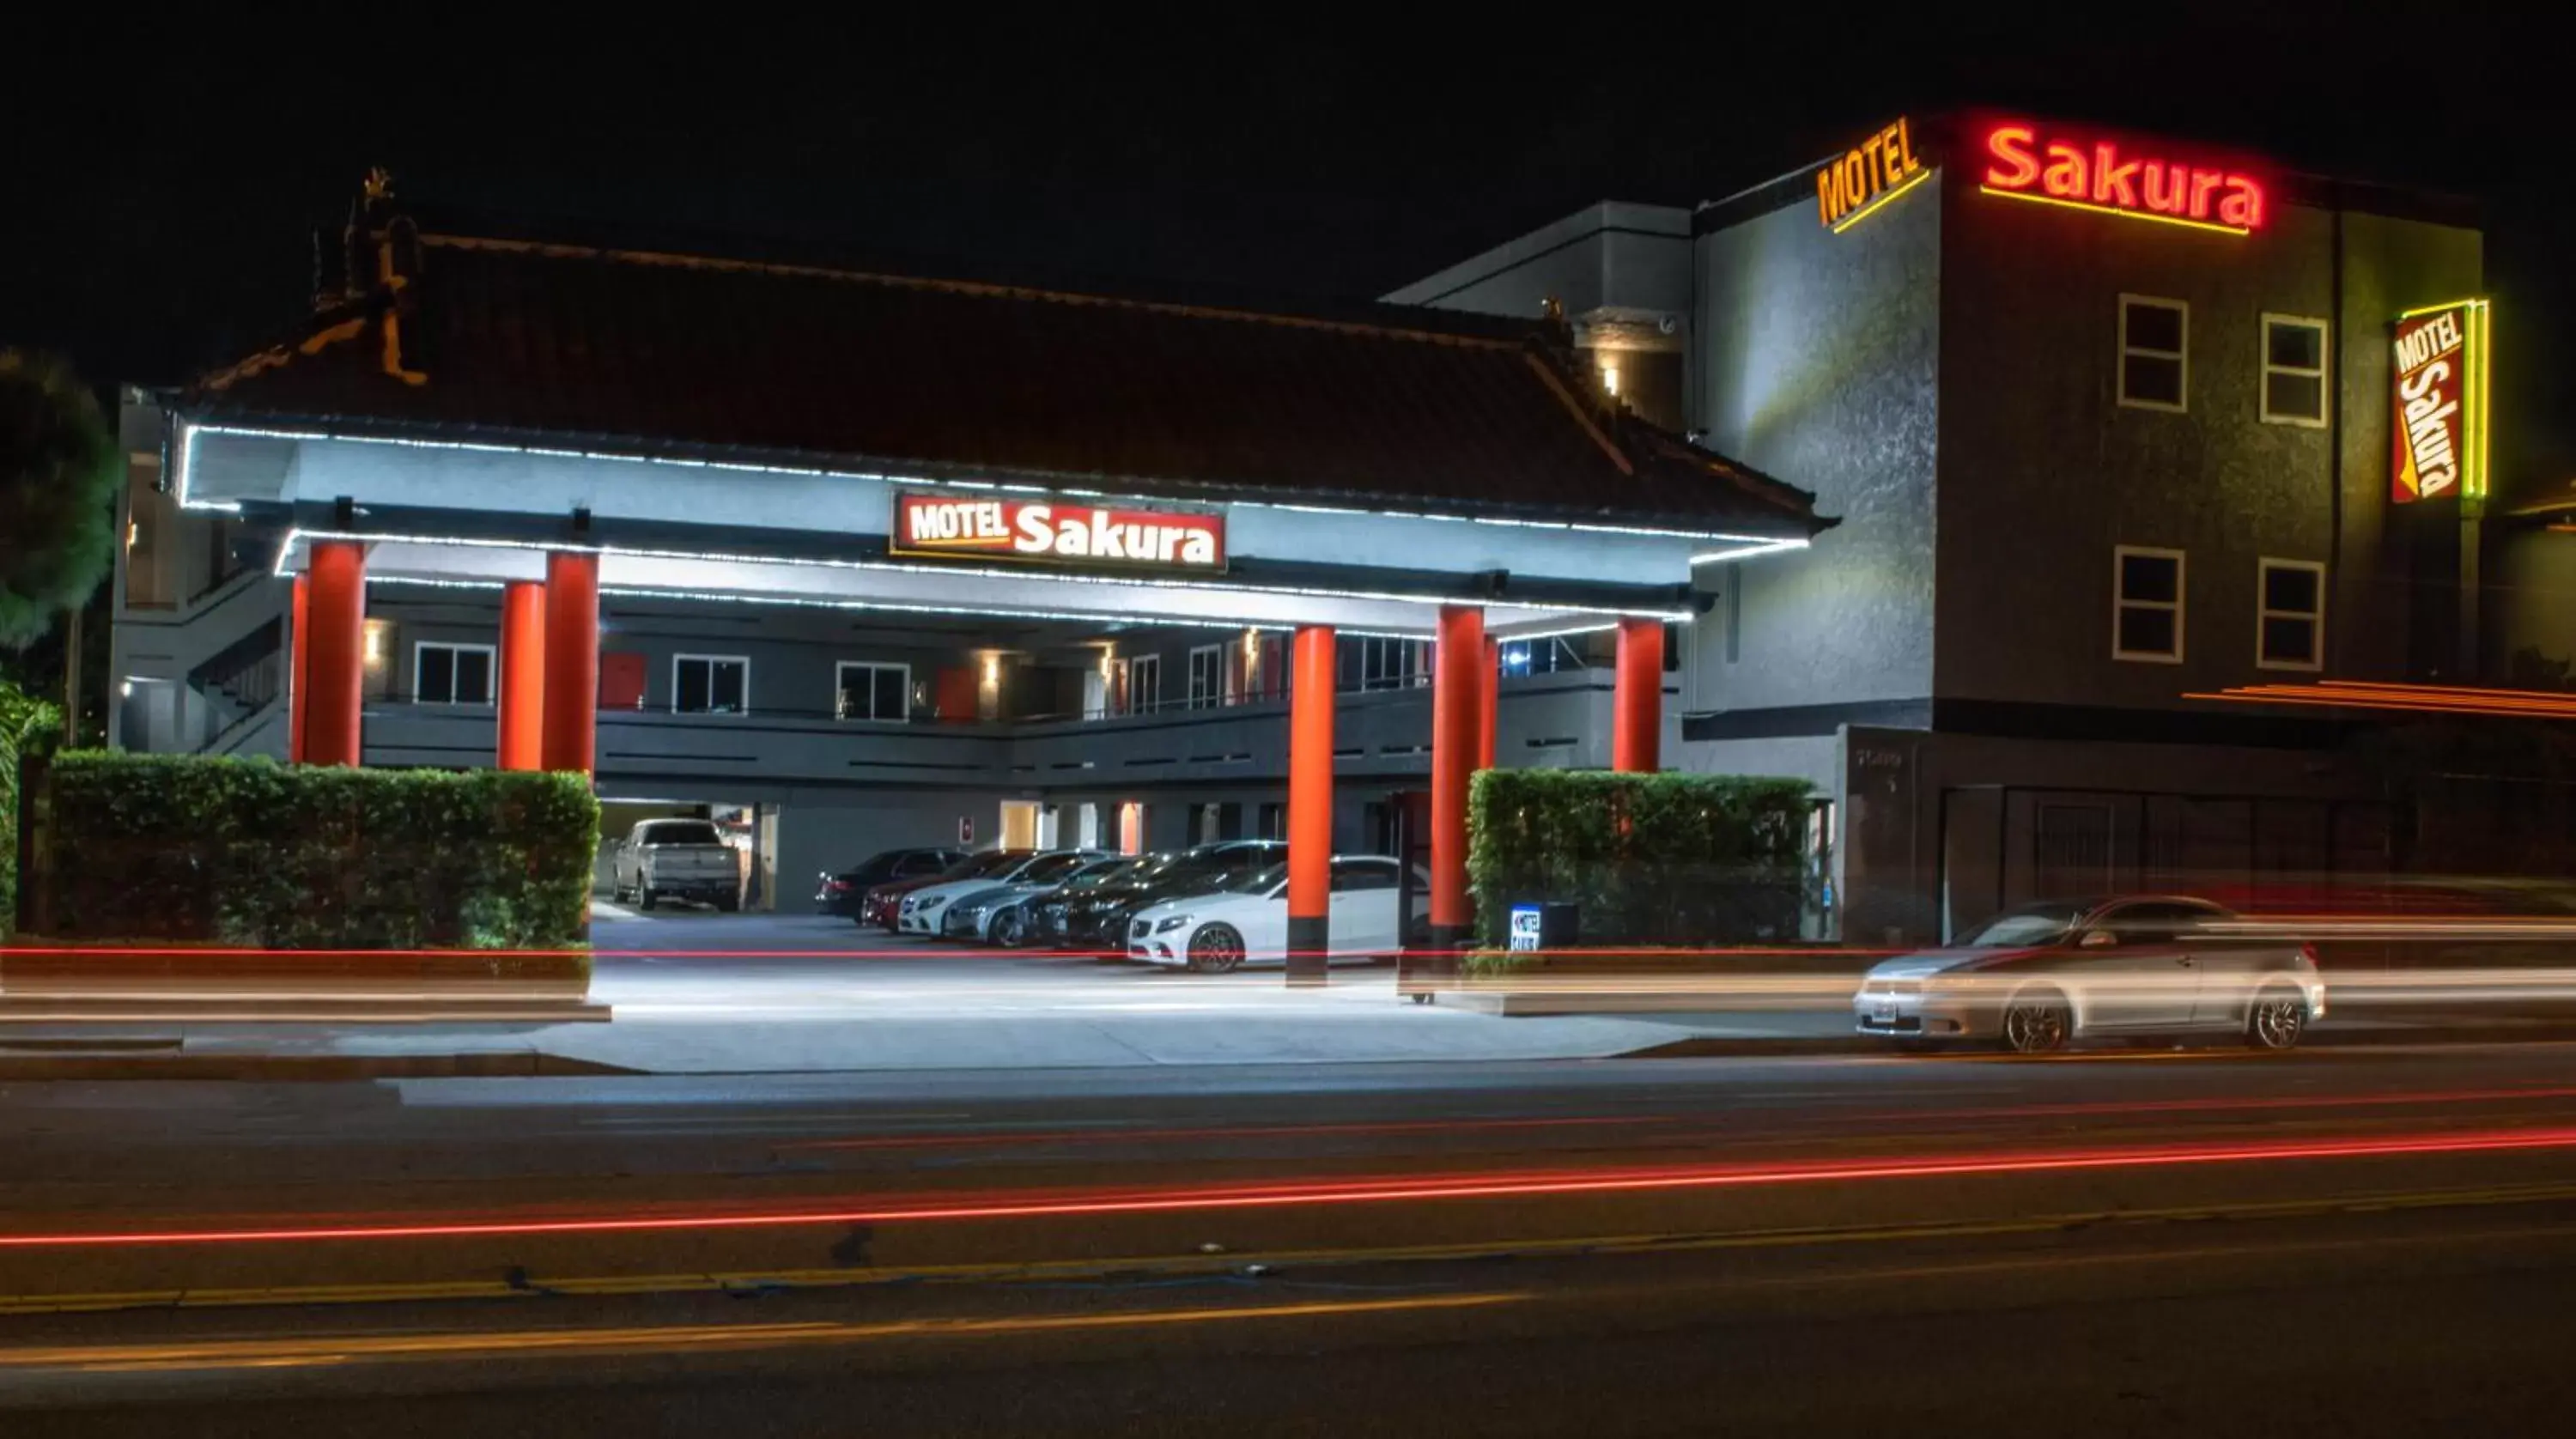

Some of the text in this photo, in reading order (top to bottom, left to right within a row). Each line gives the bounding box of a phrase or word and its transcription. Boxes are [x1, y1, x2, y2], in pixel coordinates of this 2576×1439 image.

[1817, 114, 1918, 226] MOTEL
[1986, 125, 2263, 227] Sakura
[2395, 312, 2463, 373] MOTEL
[2401, 360, 2458, 498] Sakura
[909, 501, 1214, 563] MOTEL Sakura
